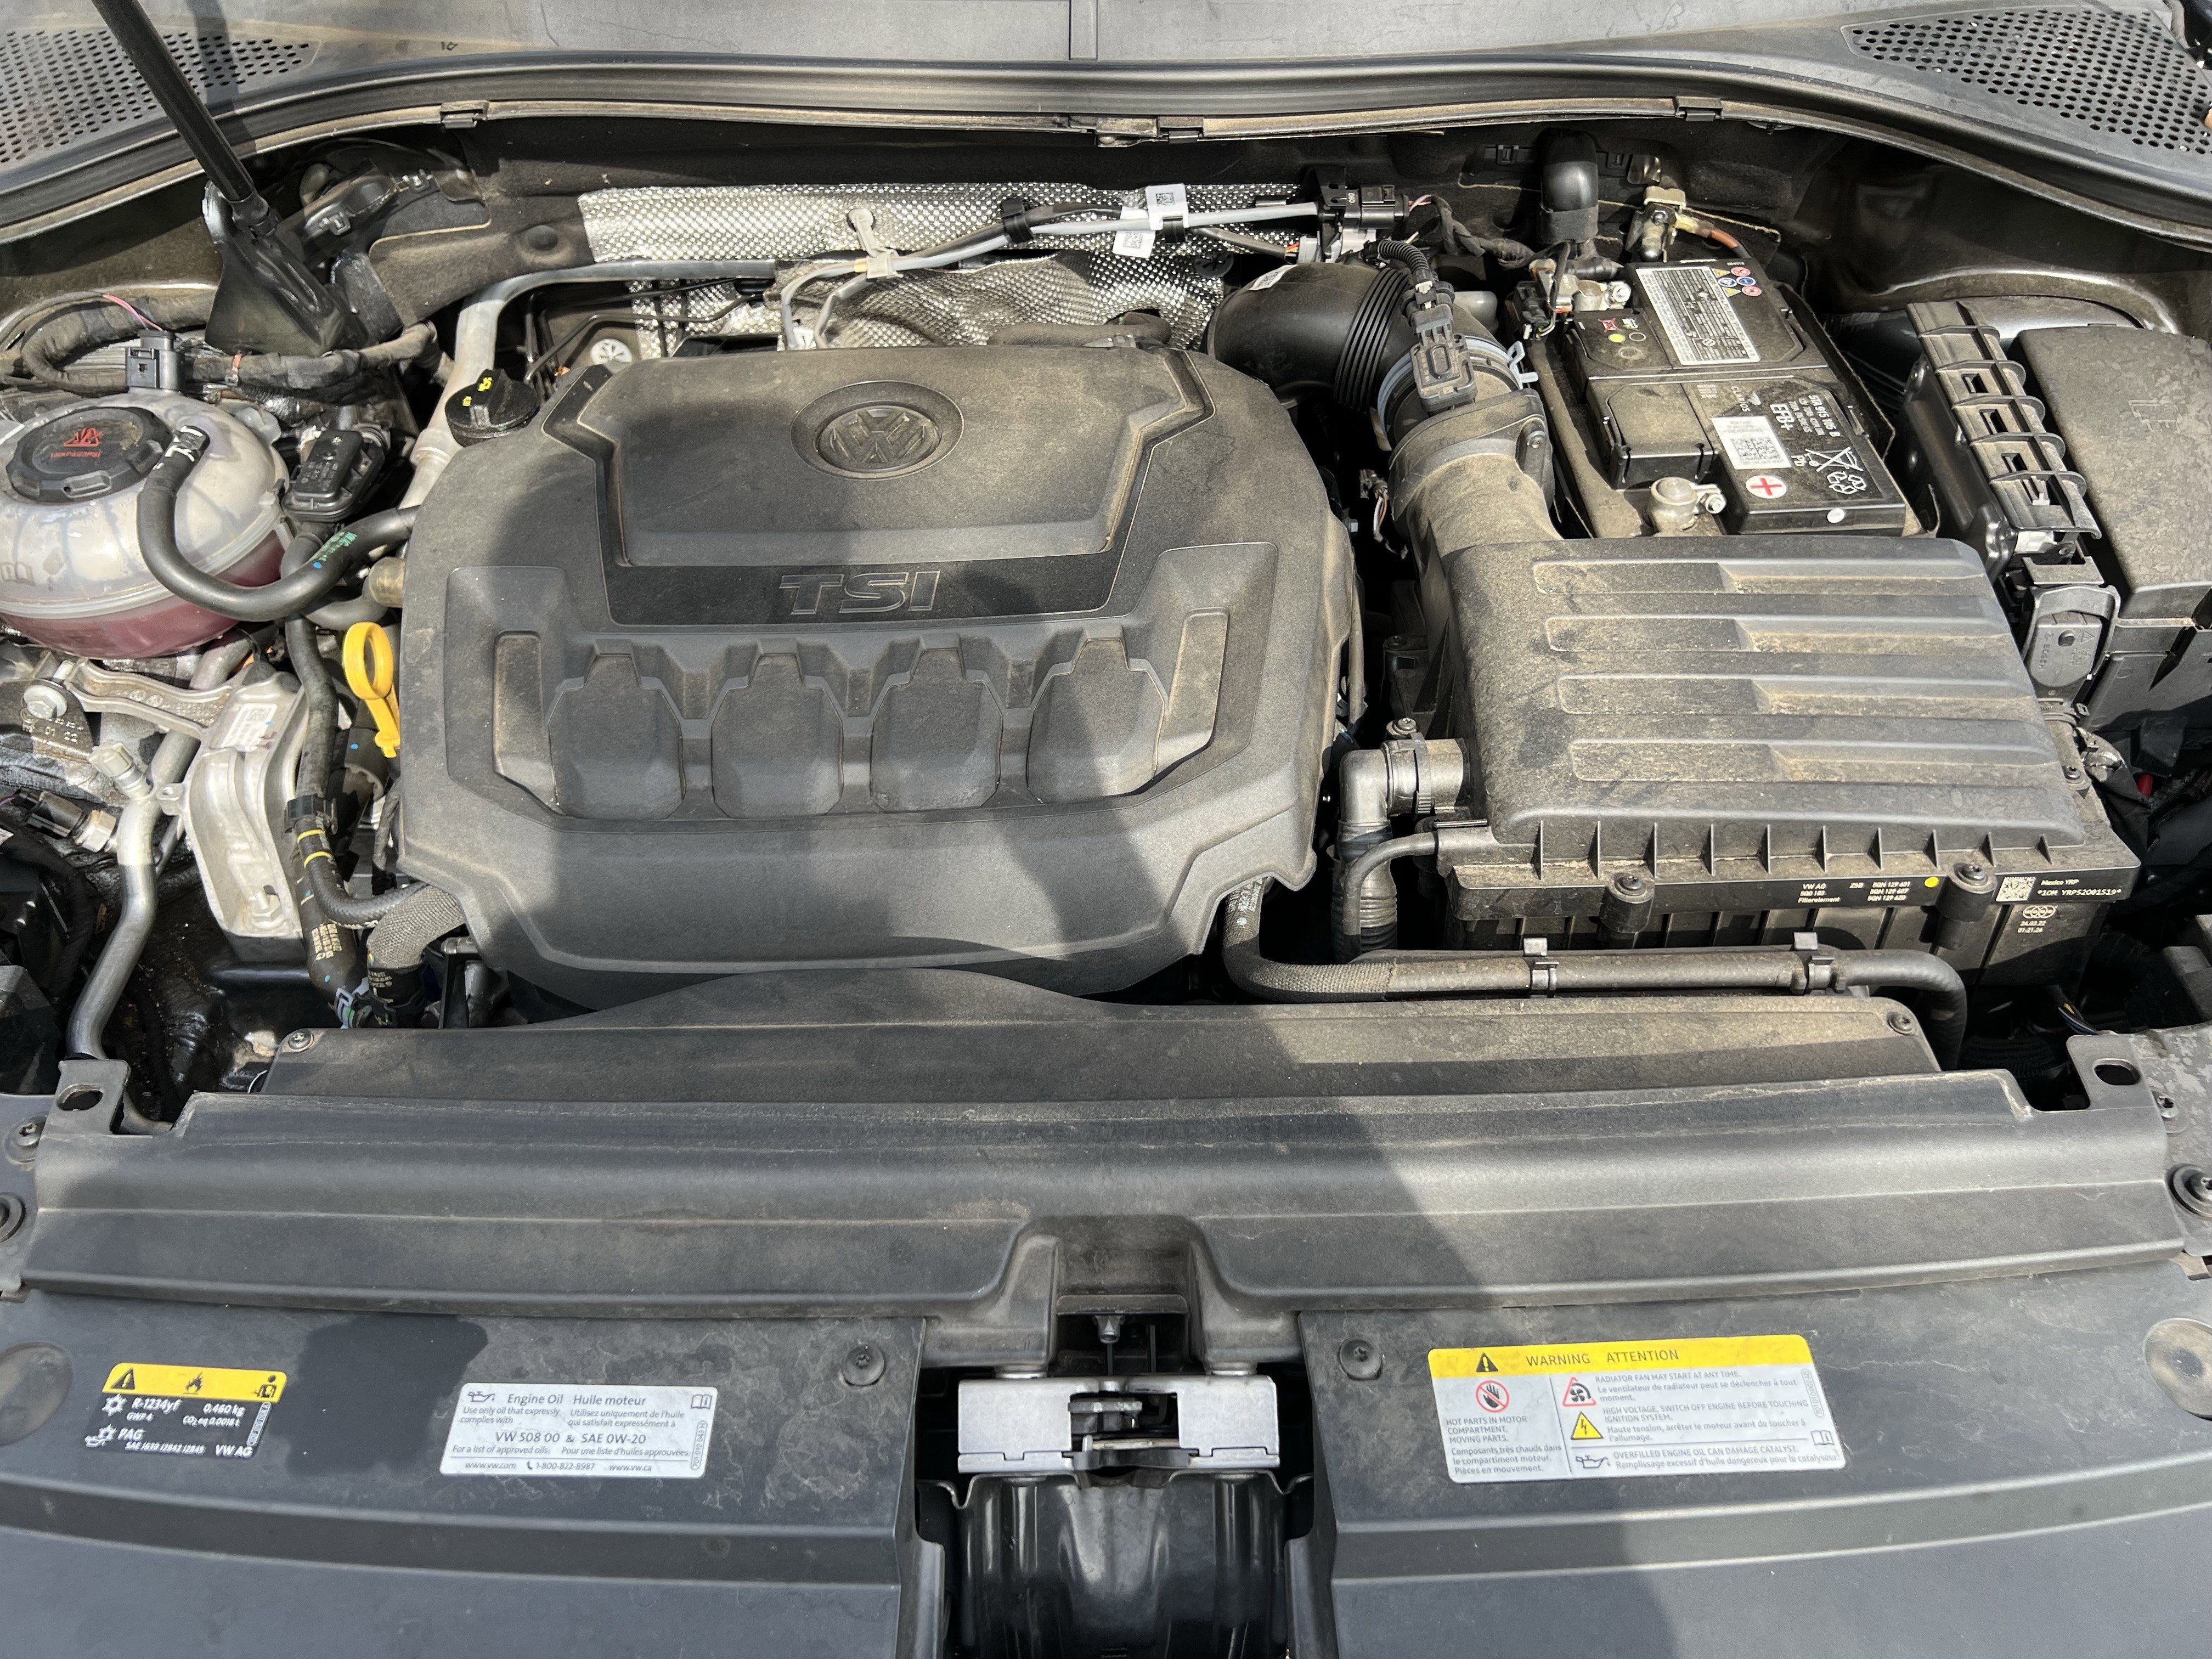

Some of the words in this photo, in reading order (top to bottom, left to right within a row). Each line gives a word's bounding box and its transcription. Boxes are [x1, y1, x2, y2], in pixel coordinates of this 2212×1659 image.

[1808, 394, 1822, 406] 5TA
[1769, 403, 1795, 431] EFB+
[1814, 406, 1830, 418] 915
[1791, 455, 1807, 467] Pb
[779, 570, 941, 616] TSI
[1525, 1352, 1591, 1367] WARNING
[1606, 1349, 1679, 1363] ATTENTION
[1595, 1374, 1633, 1383] RADIATOR
[1608, 1384, 1651, 1393] ventilateur
[1663, 1382, 1699, 1390] radiateur
[1701, 1381, 1718, 1390] peut
[1730, 1379, 1771, 1388] déclencher
[507, 1393, 545, 1406] Engine
[548, 1393, 564, 1404] Oil
[573, 1395, 602, 1405] Huile
[605, 1396, 647, 1406] moteur
[1600, 1394, 1636, 1402] moment.
[132, 1397, 182, 1414] R-1234yf
[232, 1403, 246, 1419] kg
[463, 1406, 477, 1414] Use
[479, 1406, 494, 1416] only
[524, 1407, 561, 1417] expressly
[1660, 1404, 1690, 1413] SWITCH
[1691, 1403, 1706, 1411] OFF
[1708, 1402, 1736, 1410] ENGINE
[1737, 1401, 1768, 1409] BEFORE
[1768, 1400, 1809, 1408] TOUCHING
[571, 1408, 599, 1417] Utilisez
[600, 1409, 648, 1419] uniquement
[650, 1410, 660, 1418] de
[661, 1410, 685, 1419] l'huile
[1641, 1413, 1673, 1421] SYSTEM.
[460, 1415, 494, 1425] complies
[496, 1415, 514, 1424] with
[567, 1419, 581, 1428] qui
[582, 1418, 613, 1427] satisfait
[614, 1419, 669, 1429] expressément
[1446, 1418, 1462, 1426] HOT
[1464, 1417, 1487, 1425] PARTS
[1489, 1416, 1497, 1424] IN
[1499, 1415, 1528, 1424] MOTOR
[1607, 1425, 1632, 1434] Haute
[1633, 1424, 1665, 1434] tension,
[1666, 1423, 1693, 1431] arrêter
[1768, 1419, 1799, 1427] toucher
[1801, 1418, 1806, 1426] à
[117, 1427, 145, 1441] PAG
[1447, 1426, 1508, 1435] COMPARTMENT.
[495, 1431, 517, 1442] VW
[520, 1432, 541, 1442] 508
[544, 1432, 561, 1443] 00
[566, 1434, 575, 1443] &
[581, 1433, 603, 1443] SAE
[606, 1434, 646, 1444] 0W-20
[1449, 1435, 1481, 1443] MOVING
[1482, 1434, 1509, 1443] PARTS.
[215, 1444, 236, 1457] VW
[234, 1445, 253, 1459] AG
[452, 1444, 465, 1453] For
[486, 1445, 496, 1453] of
[496, 1446, 533, 1455] approved
[596, 1447, 613, 1455] liste
[614, 1447, 643, 1455] d'huiles
[1451, 1447, 1499, 1457] Composants
[1499, 1445, 1514, 1454] très
[1515, 1444, 1543, 1453] chauds
[1613, 1450, 1661, 1459] OVERFILLED
[1662, 1449, 1692, 1457] ENGINE
[1692, 1448, 1706, 1456] OIL
[1707, 1447, 1724, 1455] CAN
[1725, 1446, 1759, 1454] DAMAGE
[1759, 1445, 1799, 1454] CATALYST.
[536, 1462, 596, 1470] 1-800-822-8987
[1462, 1455, 1519, 1466] compartiment
[1520, 1454, 1551, 1463] moteur.
[1616, 1460, 1665, 1470] Remplissage
[1666, 1458, 1697, 1467] excessif
[1699, 1457, 1725, 1466] d'huile
[1727, 1456, 1768, 1466] dangereux
[1769, 1456, 1788, 1465] pour
[1788, 1454, 1796, 1463] le
[1454, 1466, 1480, 1475] Pièces
[1493, 1464, 1544, 1473] mouvement.
